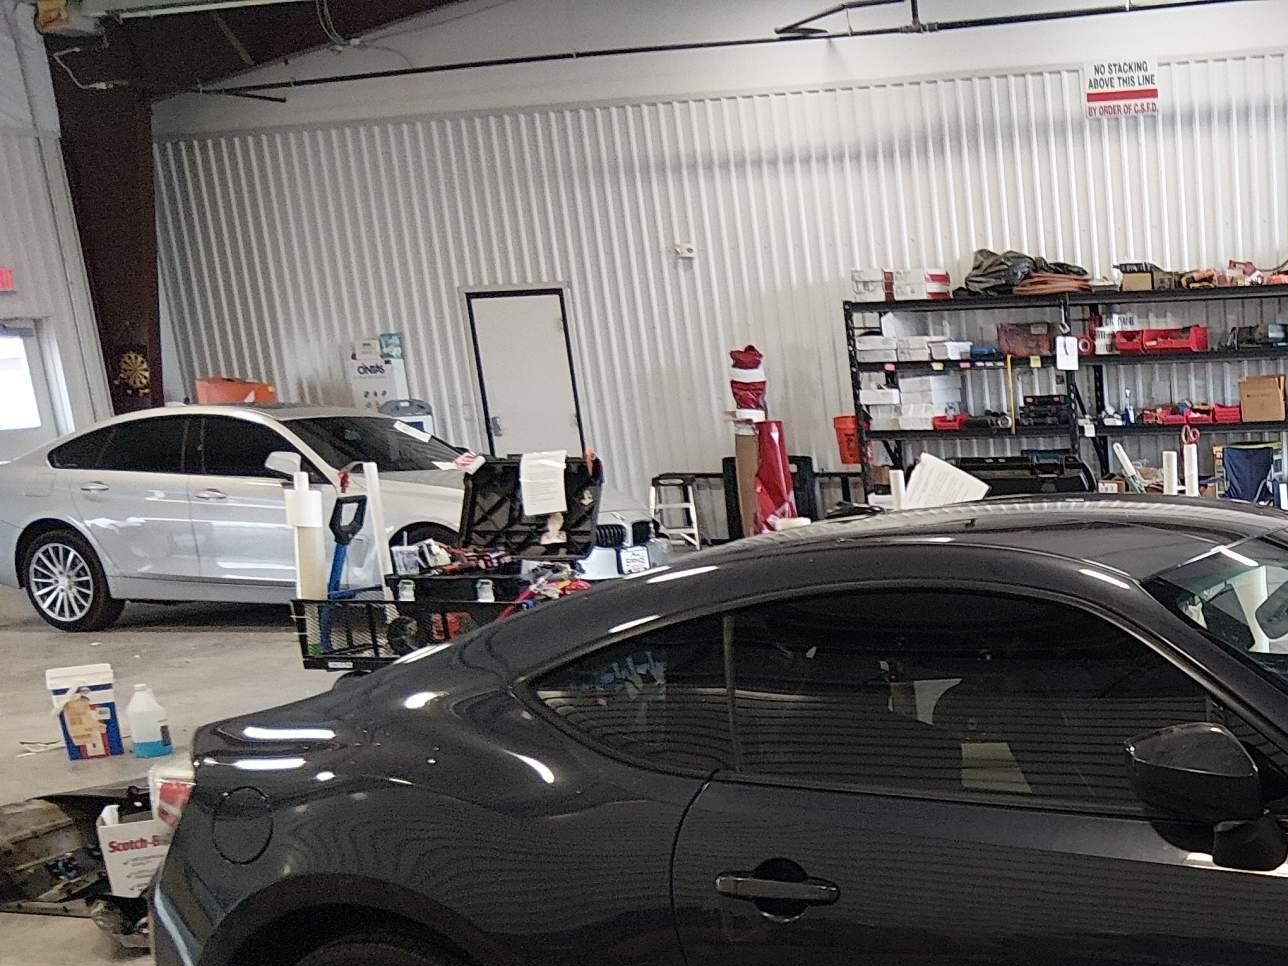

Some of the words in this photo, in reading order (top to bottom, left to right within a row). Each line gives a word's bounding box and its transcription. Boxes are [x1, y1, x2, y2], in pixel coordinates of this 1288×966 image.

[1094, 64, 1105, 75] NO
[1108, 60, 1148, 74] STACKING
[1089, 76, 1116, 89] ABOVE
[1117, 75, 1135, 87] THIS
[1137, 74, 1156, 86] LINE
[1088, 106, 1097, 117] BY
[1099, 105, 1122, 116] ORDER
[1123, 104, 1132, 115] OF
